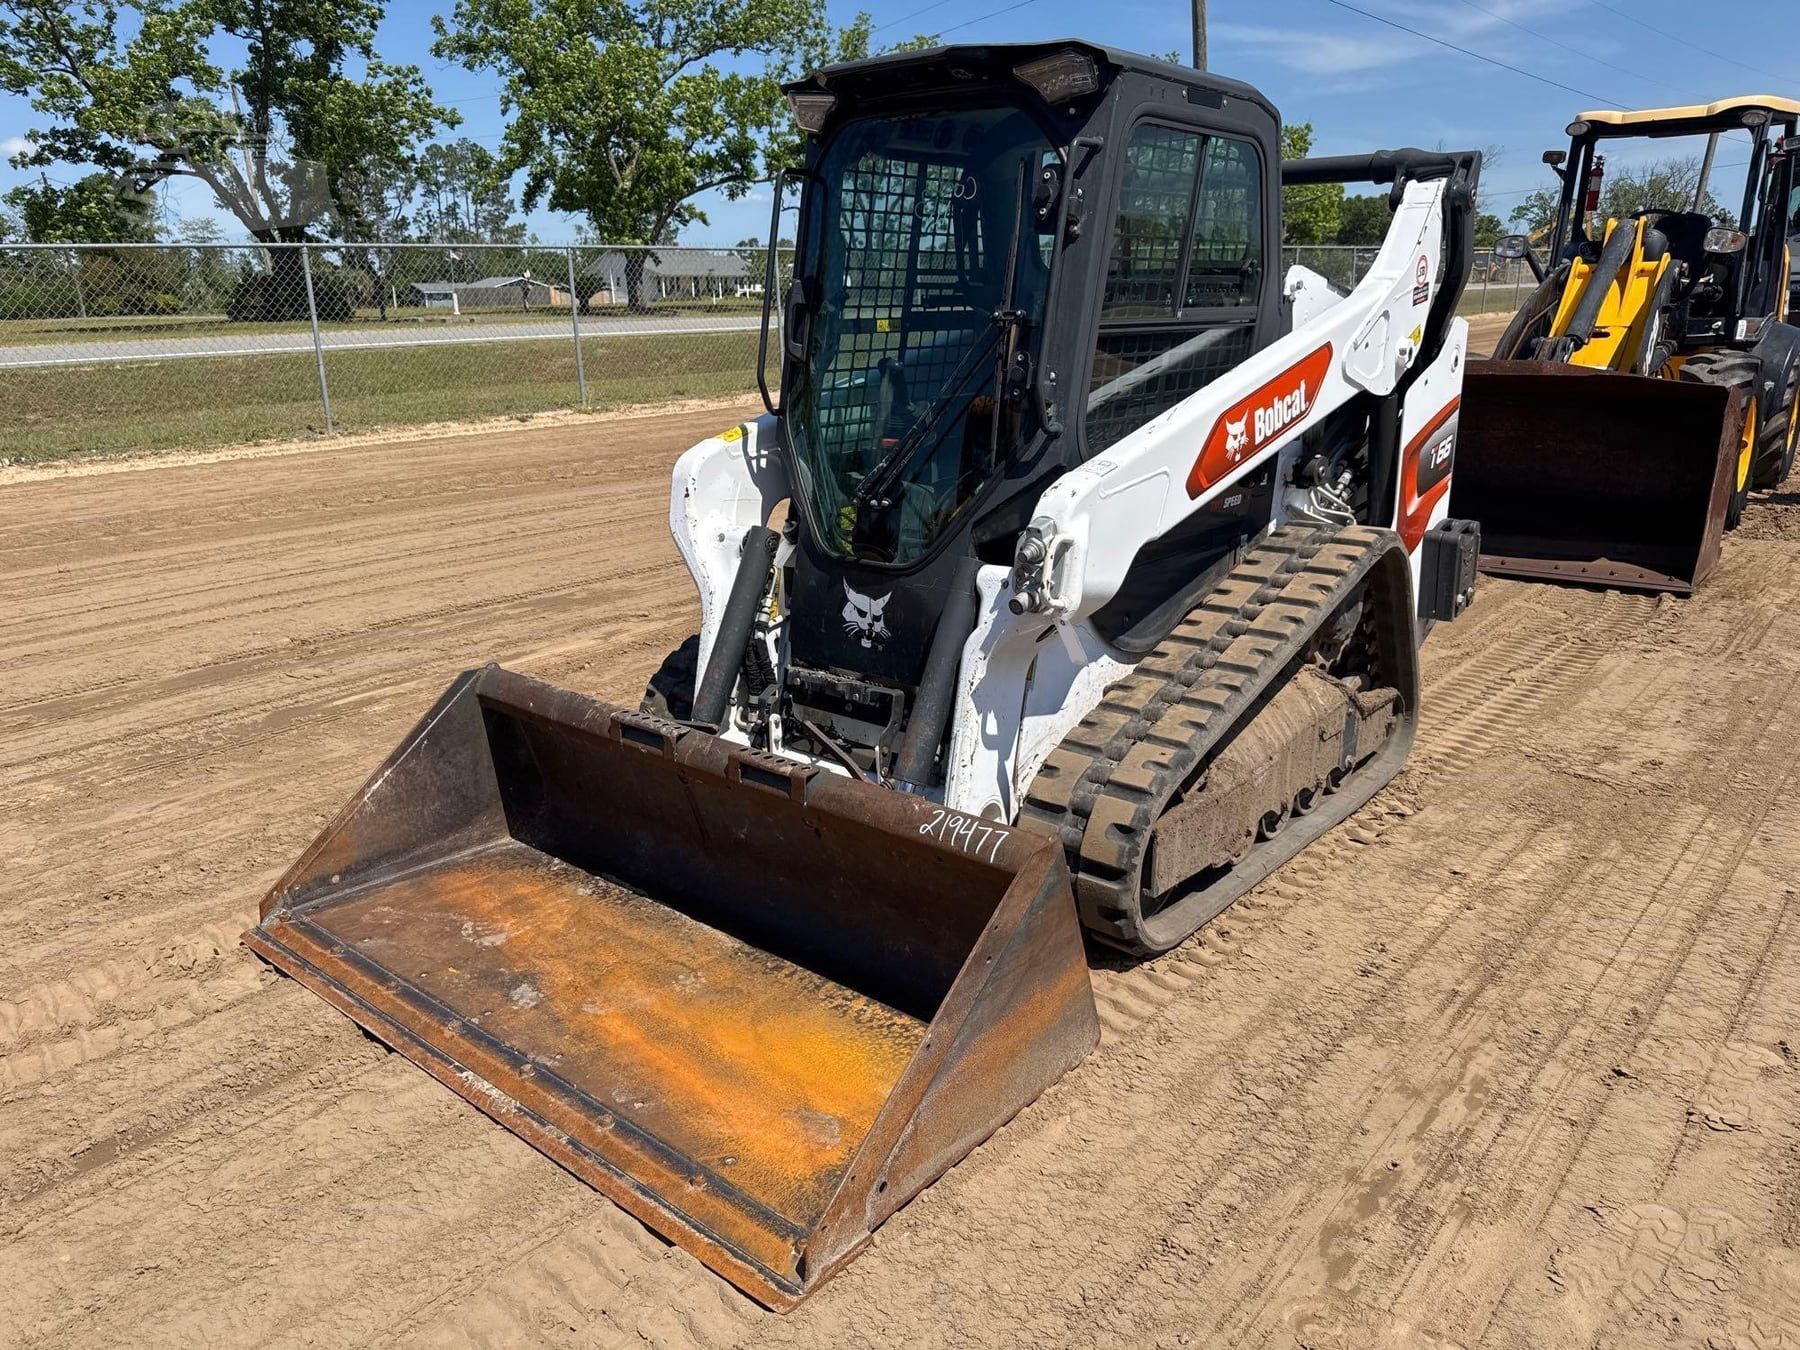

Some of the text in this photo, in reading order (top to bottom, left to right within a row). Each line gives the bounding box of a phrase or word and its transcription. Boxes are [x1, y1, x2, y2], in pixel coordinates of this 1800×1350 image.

[1254, 379, 1306, 445] Bobcat
[1223, 493, 1242, 509] SPEED
[919, 809, 1010, 864] 219477
